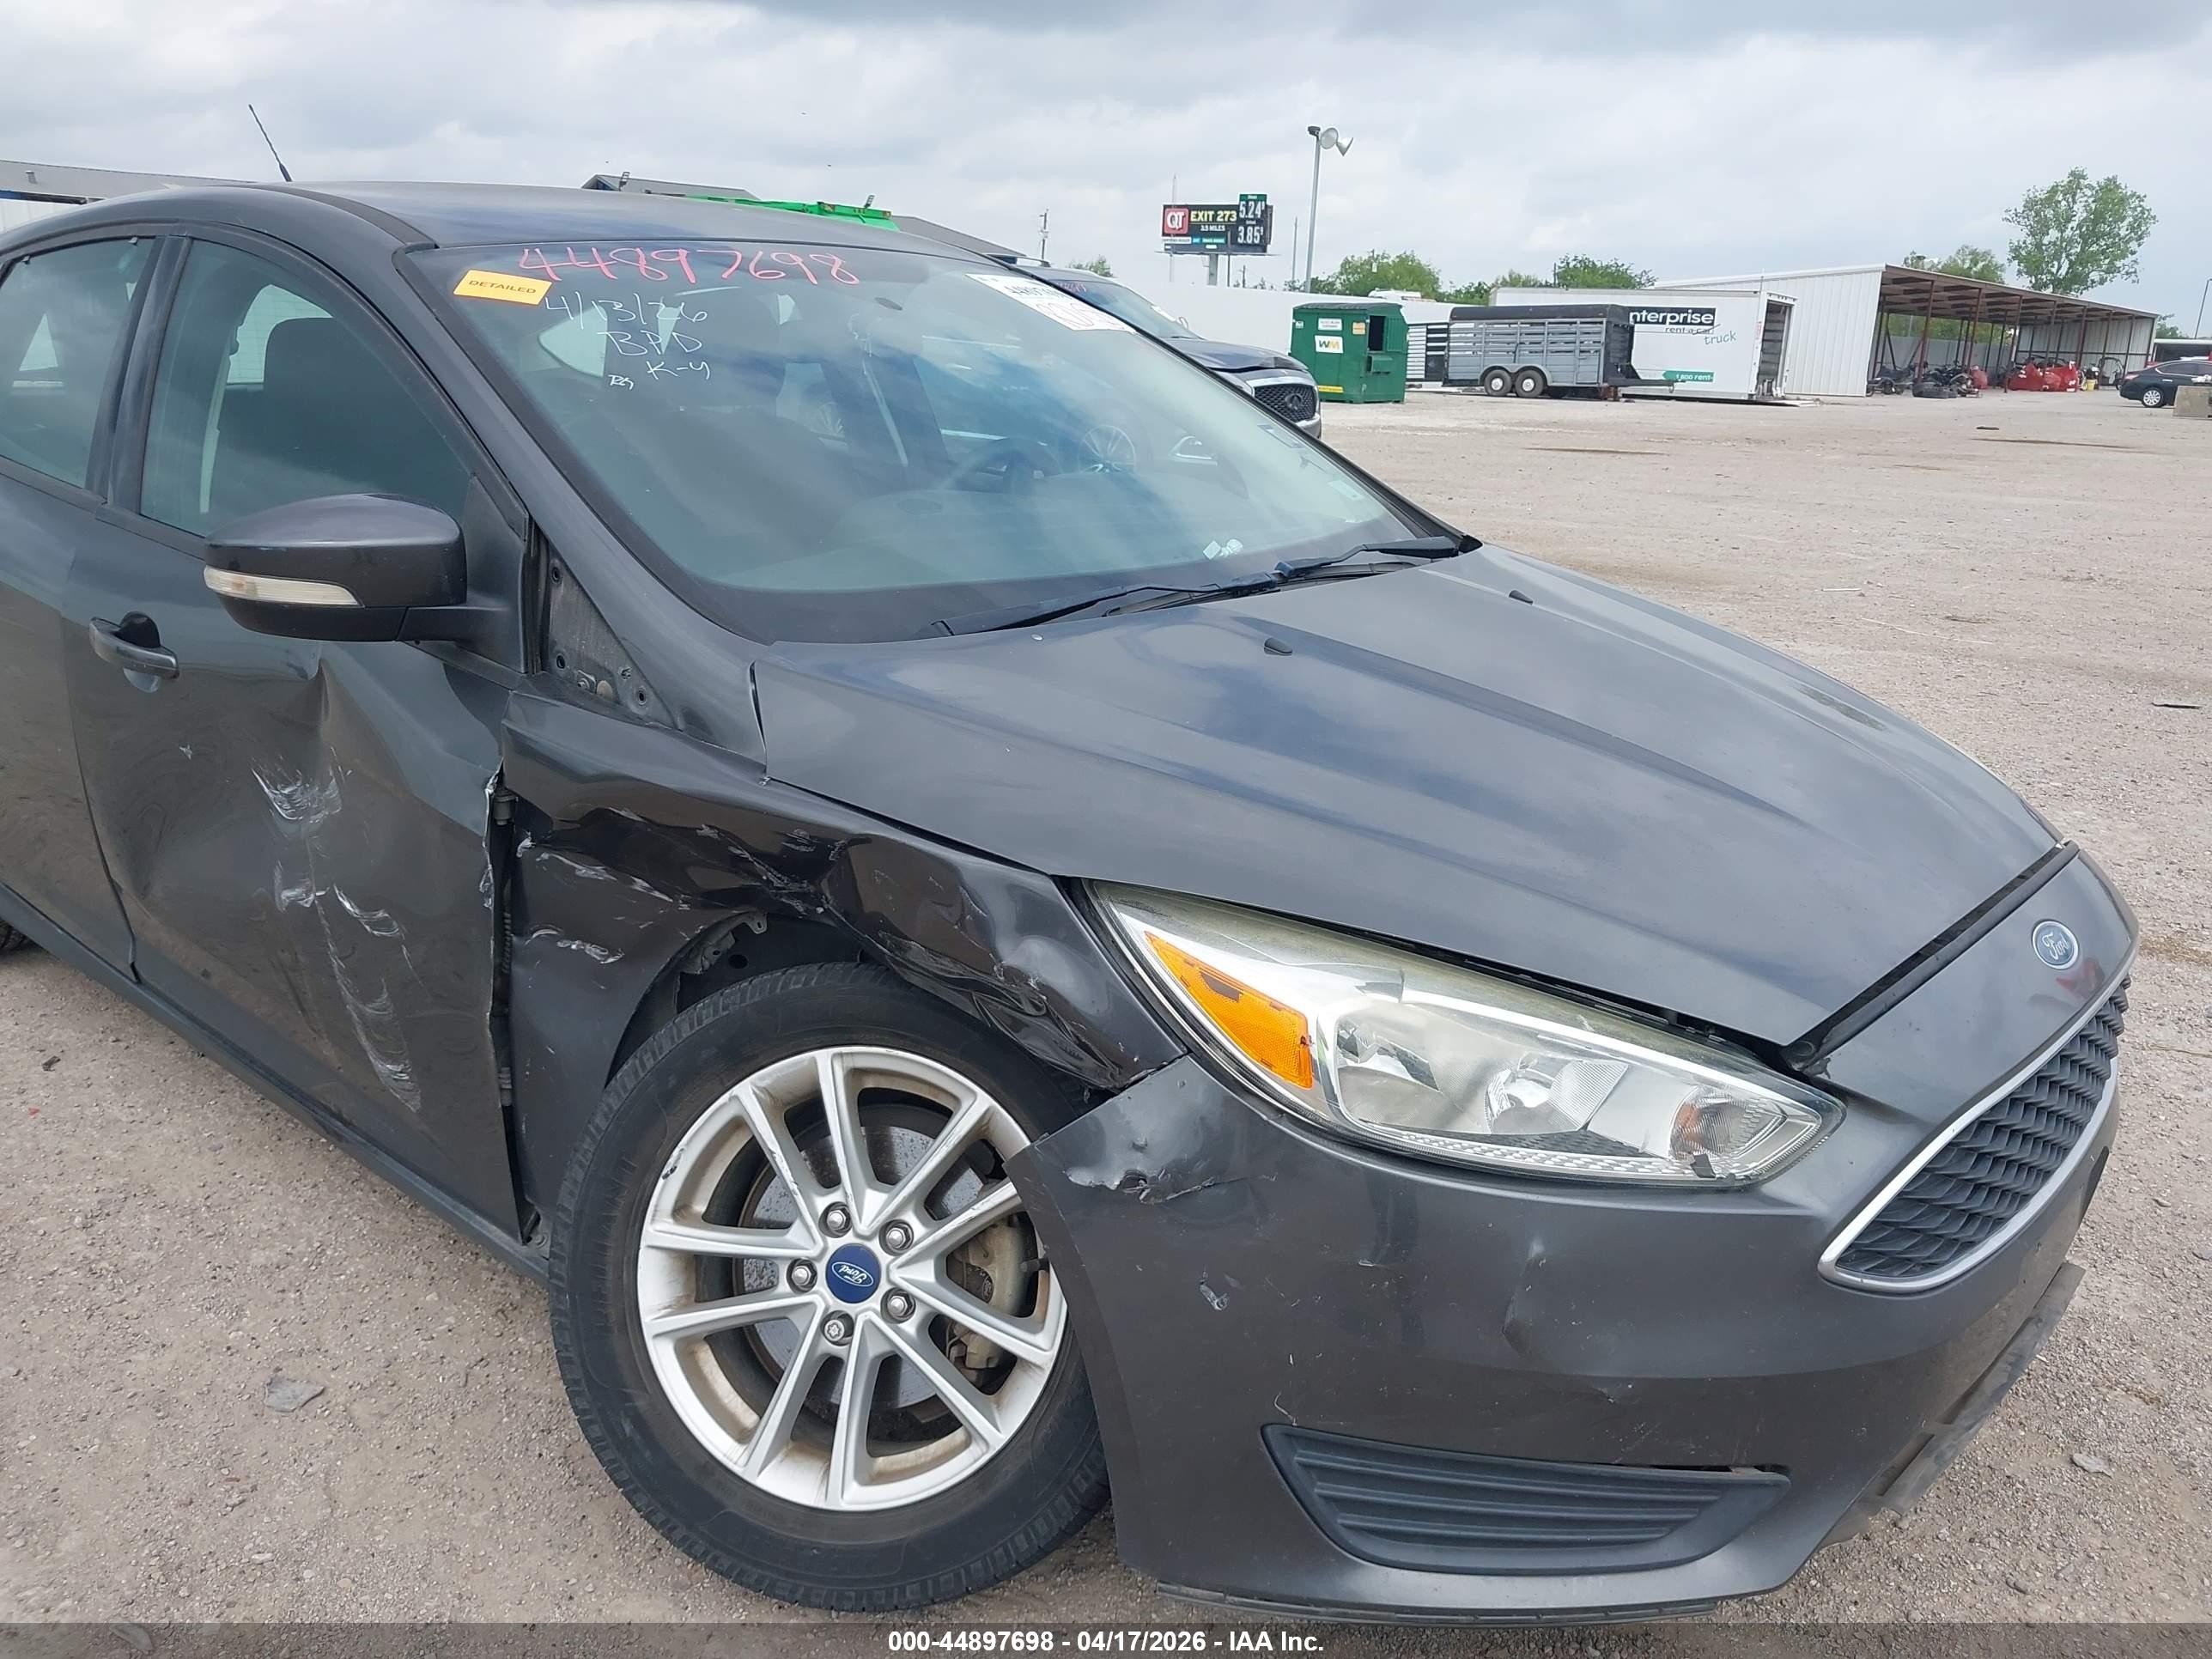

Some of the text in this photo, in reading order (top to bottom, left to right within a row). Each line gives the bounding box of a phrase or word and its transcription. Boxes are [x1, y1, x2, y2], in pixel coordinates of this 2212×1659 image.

[1166, 211, 1184, 229] QT
[1190, 210, 1237, 222] EXIT 273
[519, 247, 860, 285] 44897698
[468, 279, 537, 295] DETAILED
[1629, 309, 1714, 325] nterprise
[1318, 340, 1340, 349] WM
[1705, 330, 1737, 344] truck
[838, 1264, 867, 1284] Ford
